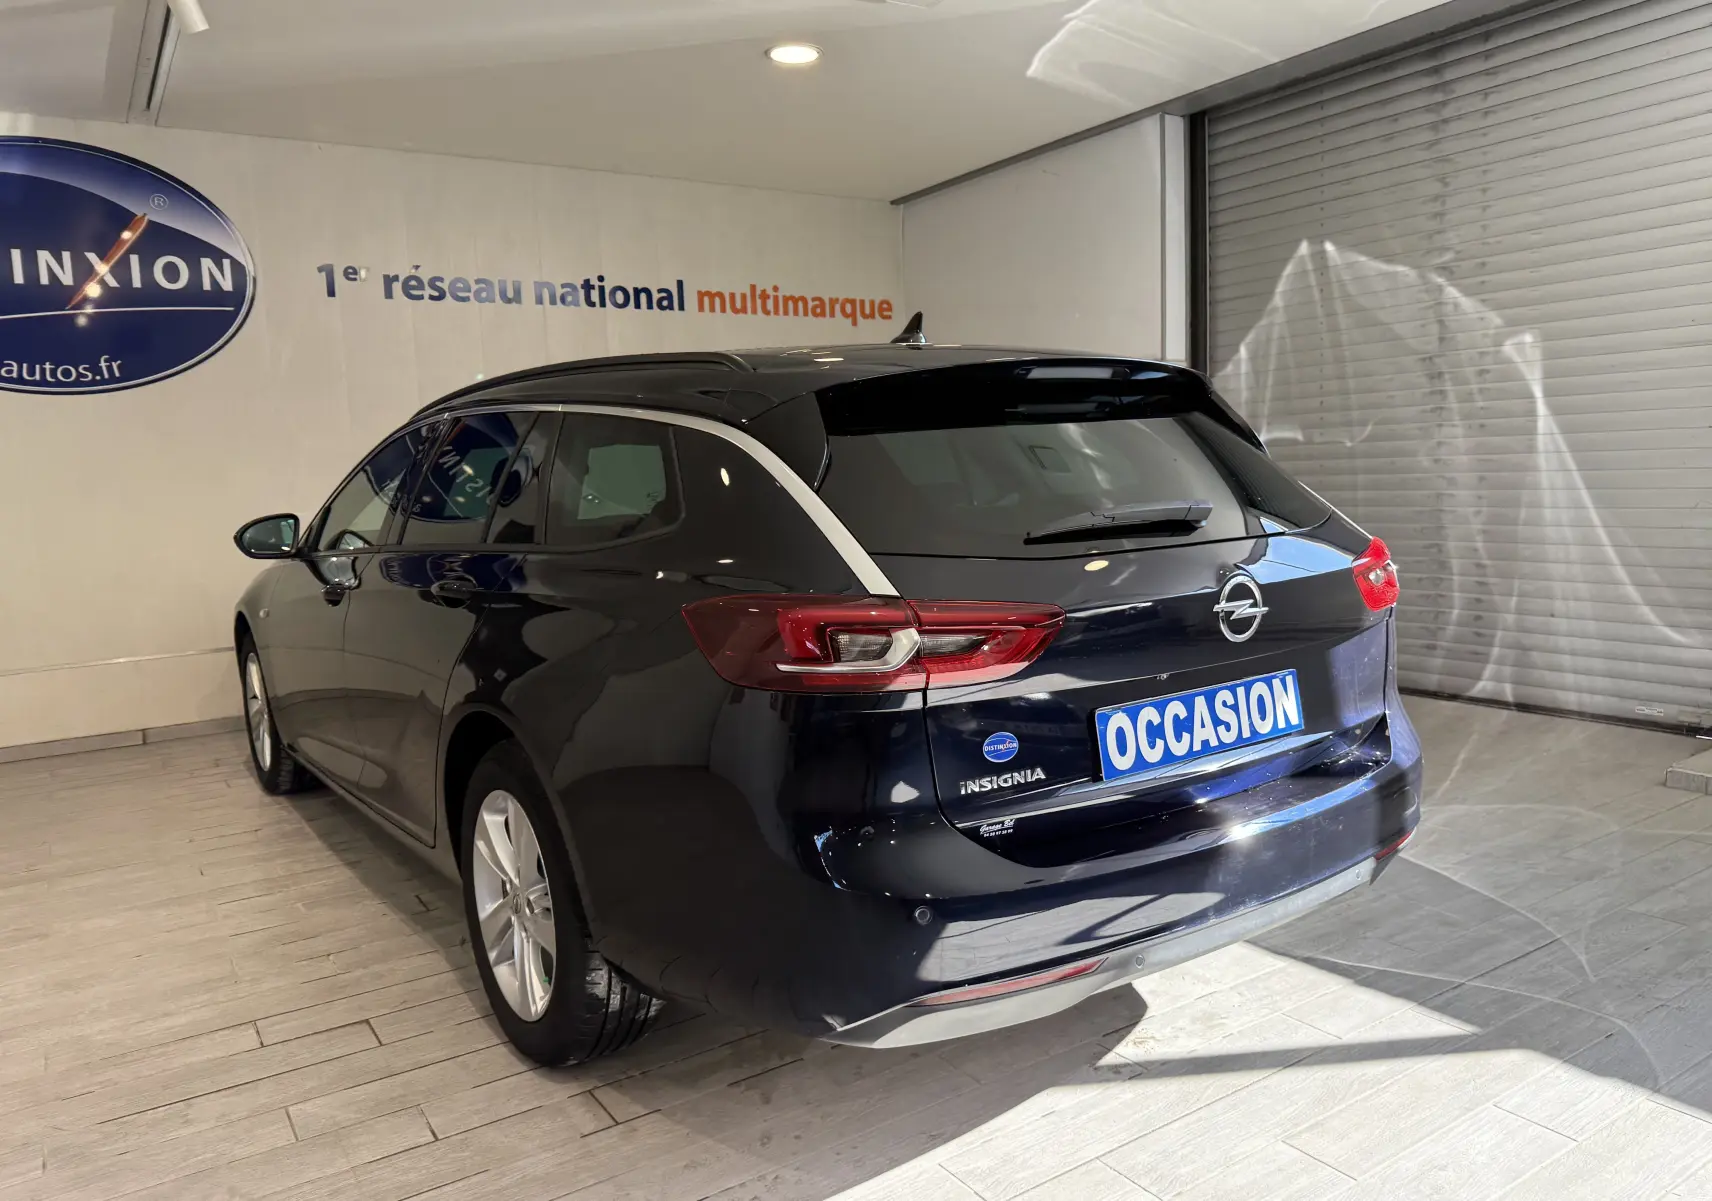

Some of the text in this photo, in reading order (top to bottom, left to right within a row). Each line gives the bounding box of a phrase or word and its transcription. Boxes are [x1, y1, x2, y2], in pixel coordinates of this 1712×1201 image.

[382, 264, 523, 305] réseau
[533, 275, 685, 312] national
[697, 283, 894, 327] multimarque
[0, 355, 122, 382] autos.fr
[1106, 674, 1300, 771] OCCASION
[960, 767, 1047, 795] INSIGNIA
